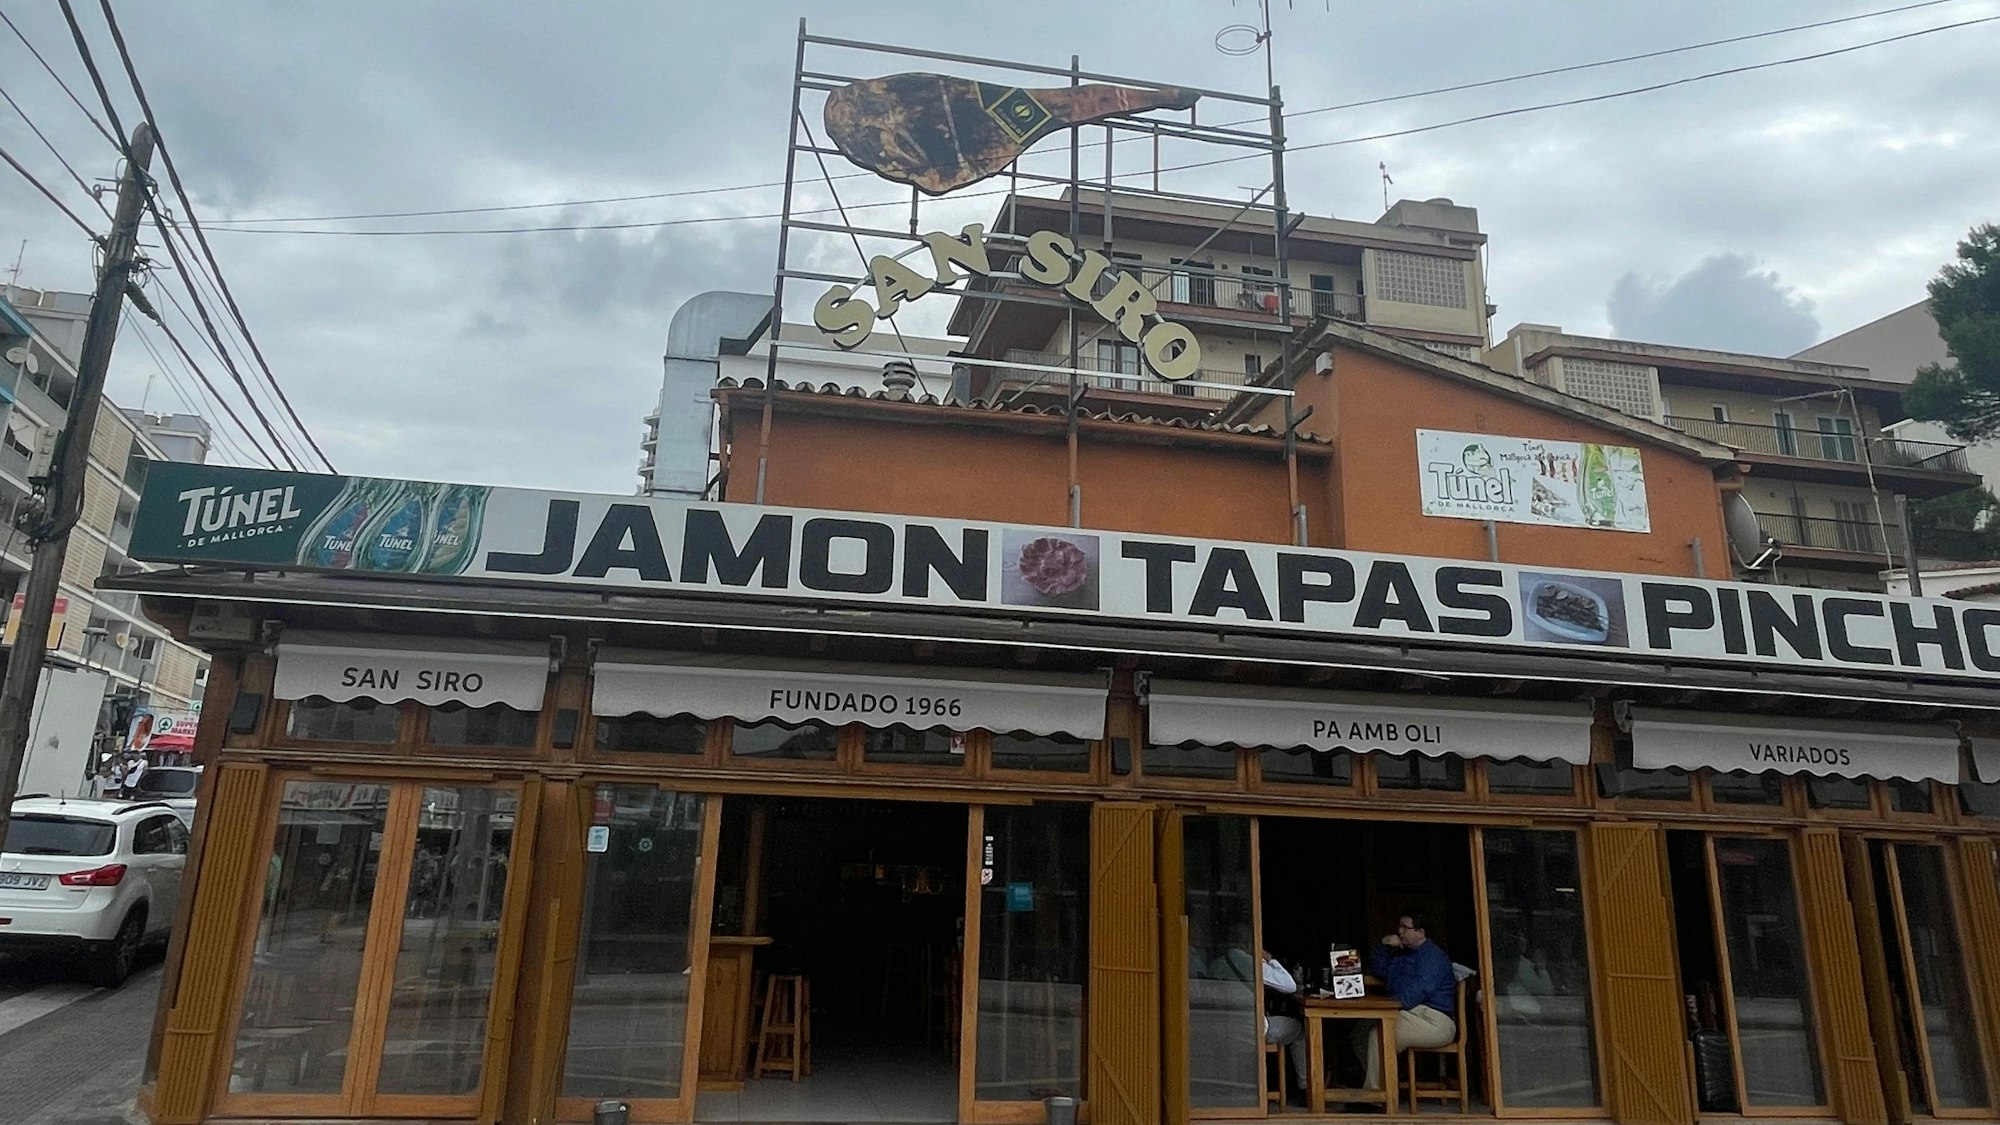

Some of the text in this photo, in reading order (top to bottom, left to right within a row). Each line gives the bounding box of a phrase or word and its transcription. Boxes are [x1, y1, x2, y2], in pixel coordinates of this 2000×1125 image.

[814, 223, 1200, 383] SAN SIRO
[1428, 462, 1513, 504] Túnel
[179, 485, 301, 536] TÚNEL
[1457, 502, 1515, 512] MALLORCA
[187, 524, 283, 548] DE MALLORCA
[485, 499, 989, 602] JAMON
[1121, 540, 1512, 637] TAPAS
[341, 666, 484, 694] SAN SIRO
[770, 688, 962, 718] FUNDADO 1966
[1314, 720, 1442, 745] PA AMB OLI
[1749, 743, 1850, 766] VARIADOS
[24, 876, 48, 888] JVZ
